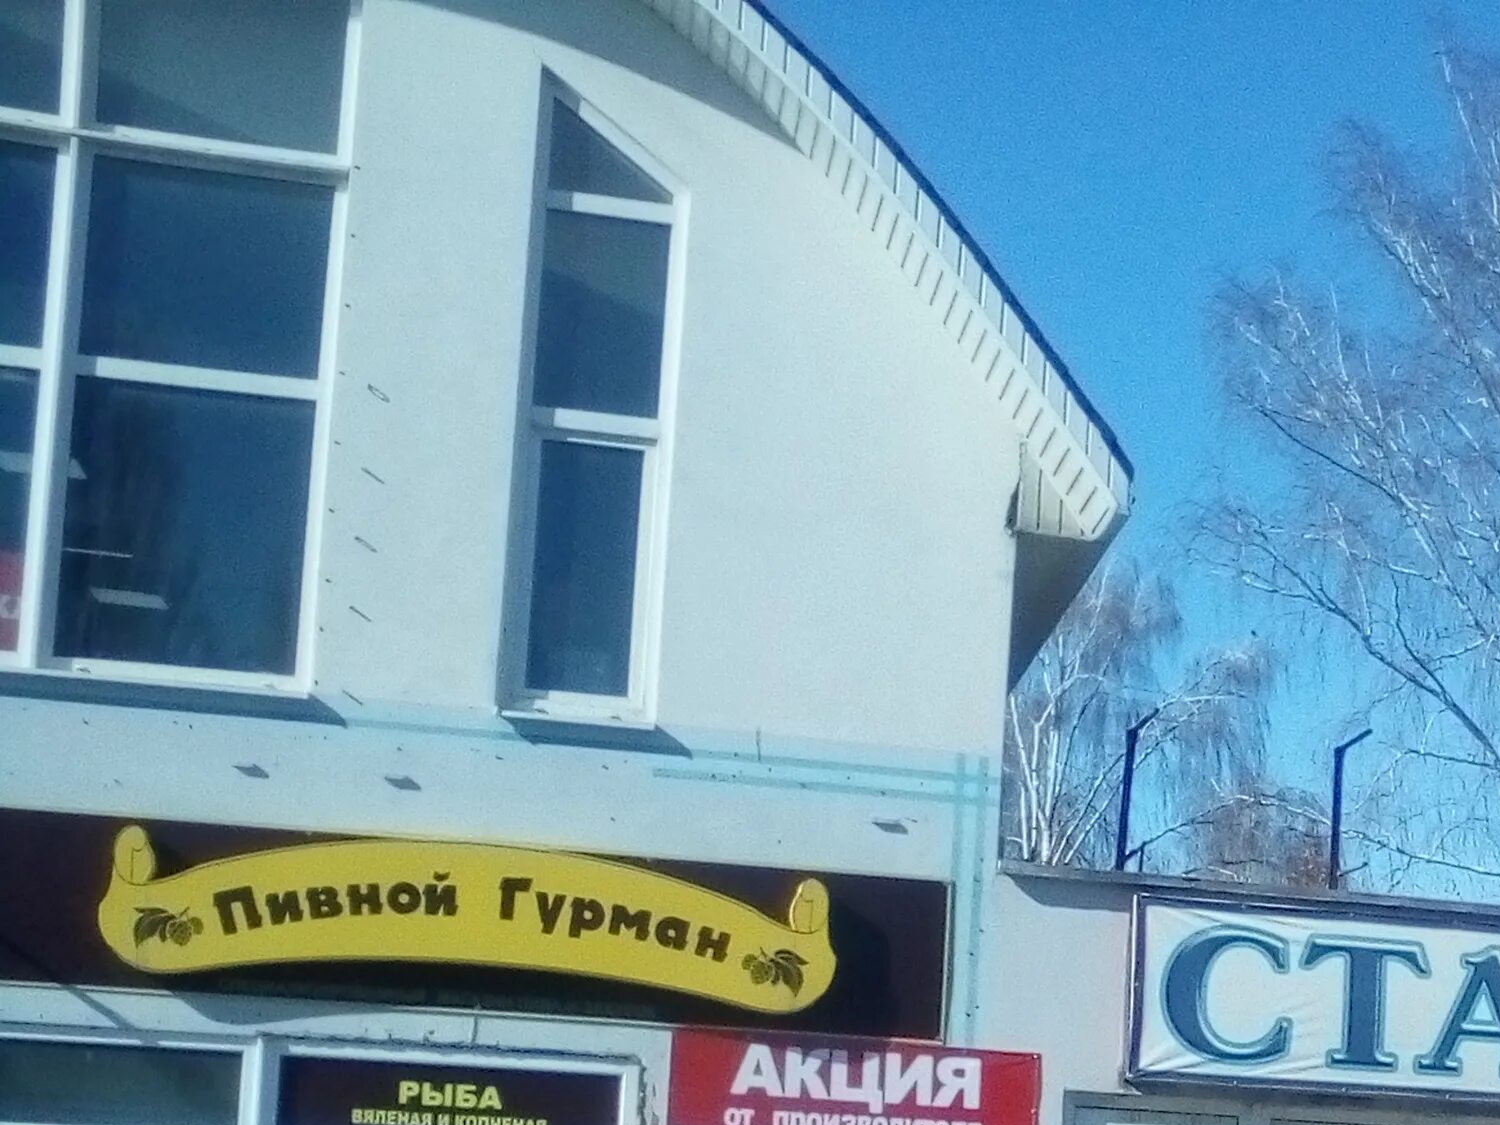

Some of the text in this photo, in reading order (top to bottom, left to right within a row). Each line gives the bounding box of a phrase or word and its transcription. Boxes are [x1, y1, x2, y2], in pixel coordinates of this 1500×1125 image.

[213, 871, 732, 964] Пивной Гурман
[397, 1079, 503, 1111] РЫБА
[730, 1042, 983, 1114] АКЦИЯ
